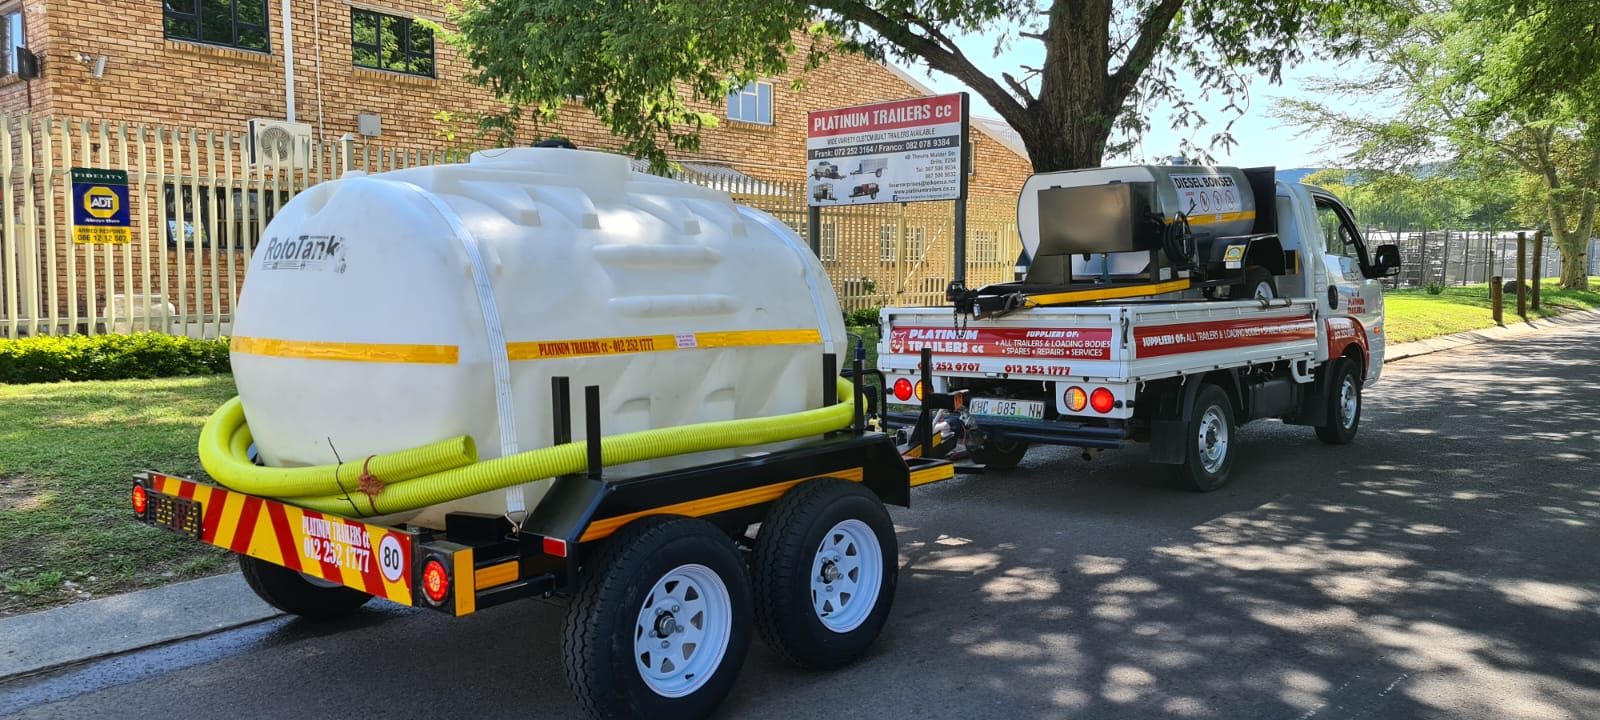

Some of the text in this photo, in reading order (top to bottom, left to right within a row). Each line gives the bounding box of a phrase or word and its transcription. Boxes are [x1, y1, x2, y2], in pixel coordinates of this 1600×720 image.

[814, 112, 869, 132] PLATINUM
[873, 104, 931, 125] TRAILERS
[855, 133, 873, 143] CUSTOM
[873, 132, 887, 141] BUILT
[888, 130, 909, 139] TRAILERS
[909, 127, 935, 137] AVAILABLE
[835, 148, 845, 156] 072
[847, 147, 858, 155] 252
[879, 144, 904, 152] Franco:
[906, 141, 918, 150] 082
[919, 139, 931, 148] 078
[933, 138, 950, 147] 9384
[74, 172, 124, 180] FIDELITY
[1174, 176, 1234, 189] DIESEL BOWSER
[91, 197, 113, 208] ADT
[264, 235, 340, 260] RotoTank
[909, 329, 978, 340] PLATINUM
[1026, 330, 1064, 338] SUPPLIERS
[1142, 335, 1175, 347] SUPPLIERS
[1186, 333, 1197, 343] ALL
[1197, 331, 1219, 341] TRAILERS
[1224, 329, 1245, 339] LOADING
[539, 342, 569, 356] PLATINUM
[571, 340, 600, 355] TRAILERS
[614, 339, 625, 353] 012
[627, 339, 639, 352] 252
[640, 338, 655, 352] 1777
[908, 340, 968, 353] TRAILERS
[1000, 339, 1012, 347] ALL
[1014, 339, 1043, 347] TRAILERS
[1051, 340, 1084, 348] LOADING
[1085, 340, 1111, 348] BODIES
[1006, 347, 1103, 356] SPARES REPAIRS SERVICES
[936, 362, 953, 371] 252
[955, 362, 980, 372] 0707
[1005, 364, 1071, 376] 012 252 1777
[997, 401, 1016, 415] 085
[1028, 403, 1044, 418] NW
[302, 515, 331, 539] PLATINUM
[332, 521, 362, 547] TRAILERS
[304, 537, 370, 573] 012 252 1777
[384, 546, 399, 570] 80
